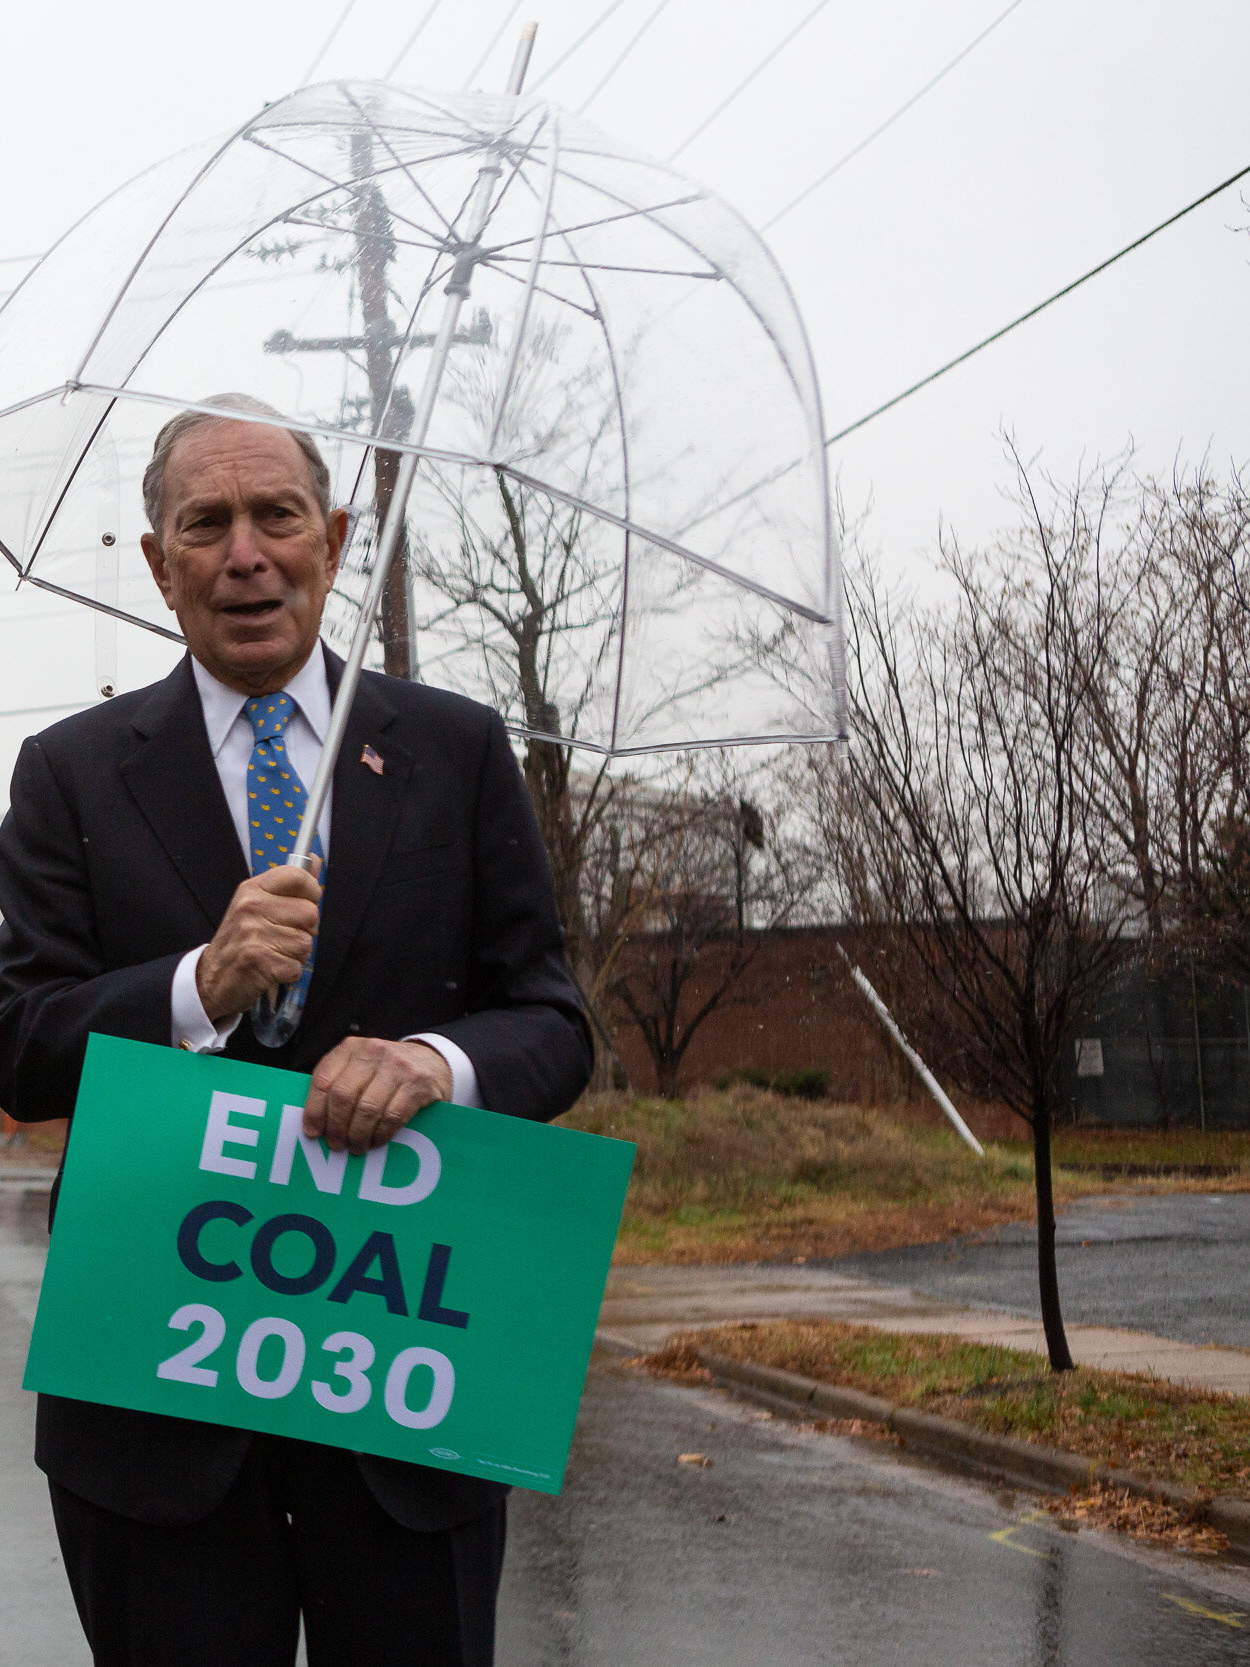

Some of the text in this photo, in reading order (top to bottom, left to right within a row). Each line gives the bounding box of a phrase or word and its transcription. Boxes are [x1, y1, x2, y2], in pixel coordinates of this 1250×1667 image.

[198, 1090, 442, 1206] END
[177, 1200, 470, 1329] COAL
[157, 1303, 456, 1430] 2030
